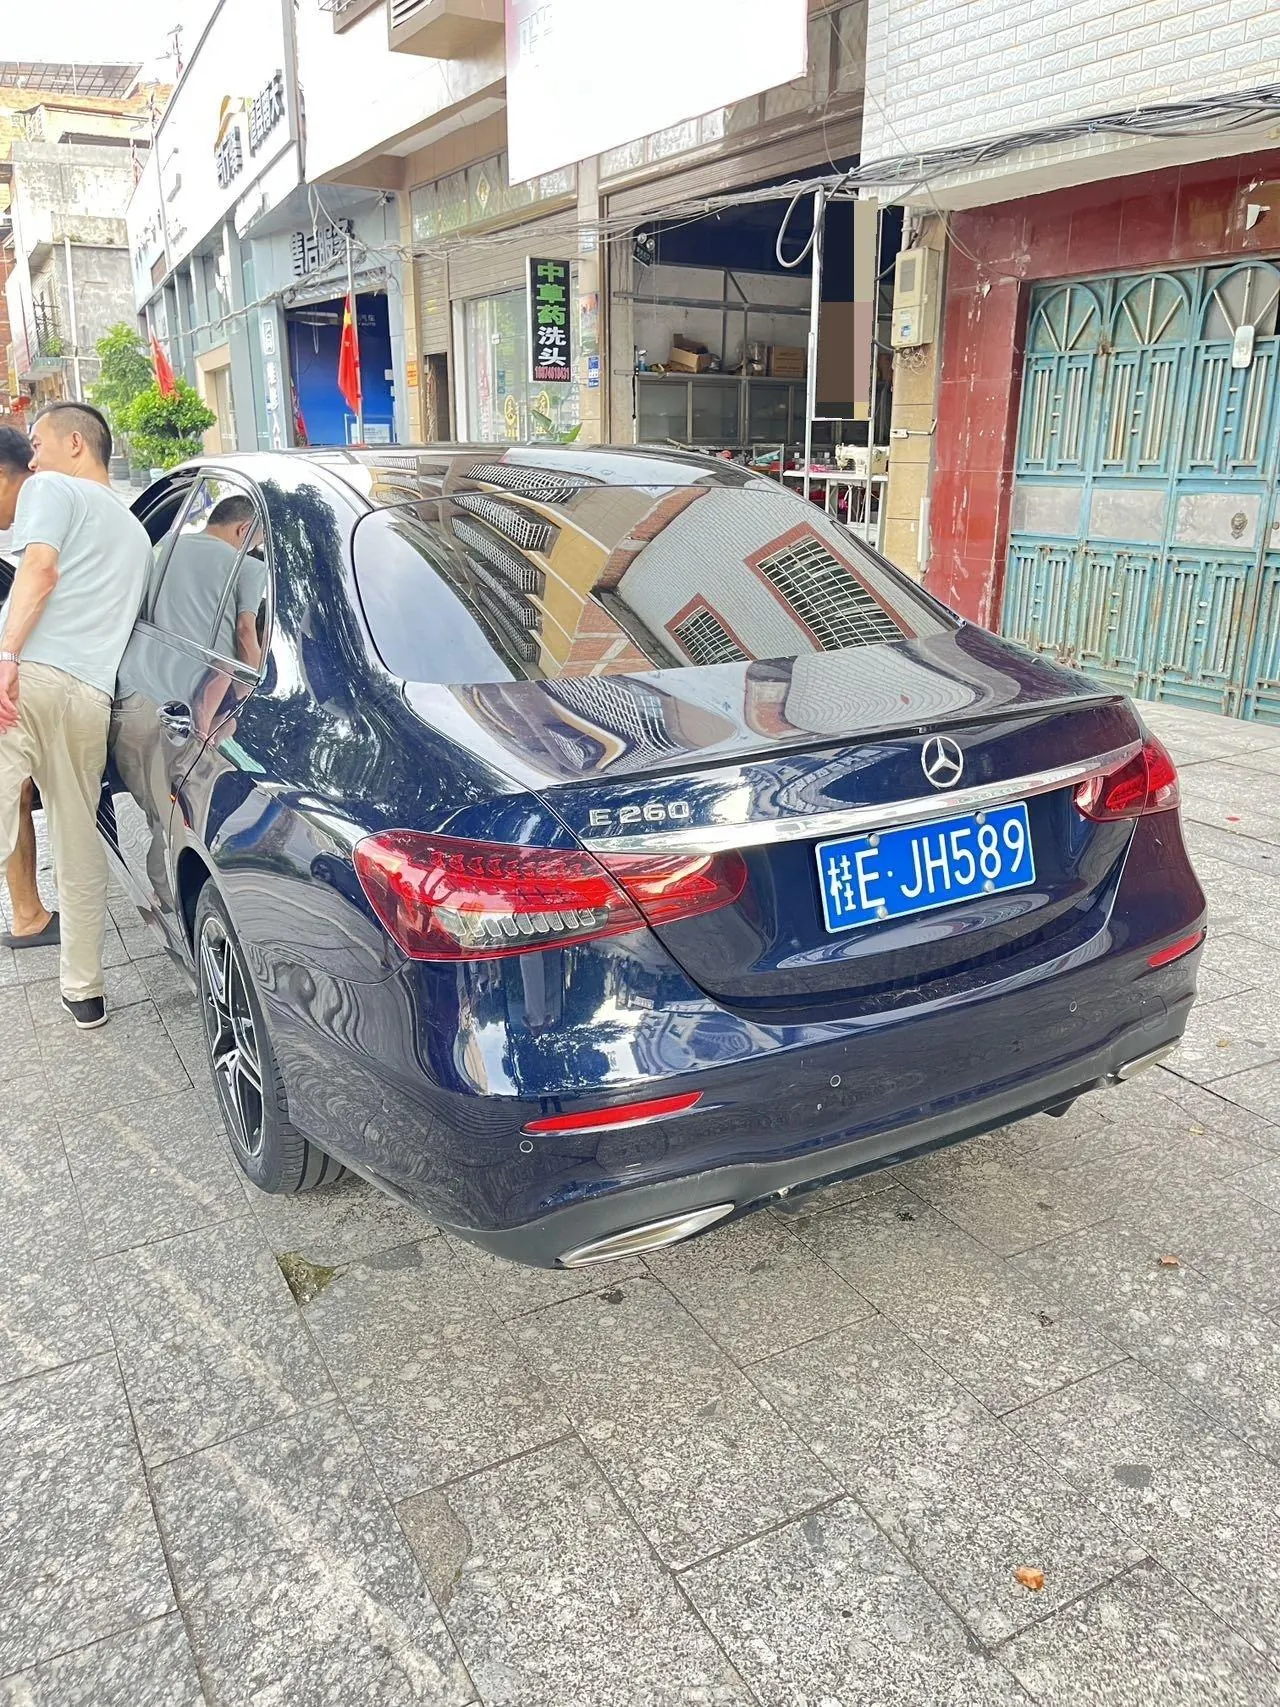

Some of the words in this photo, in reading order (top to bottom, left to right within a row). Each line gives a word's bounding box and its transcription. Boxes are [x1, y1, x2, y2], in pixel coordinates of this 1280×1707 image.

[537, 261, 566, 366] 中草药洗头
[589, 808, 612, 826] E
[620, 801, 690, 824] 260
